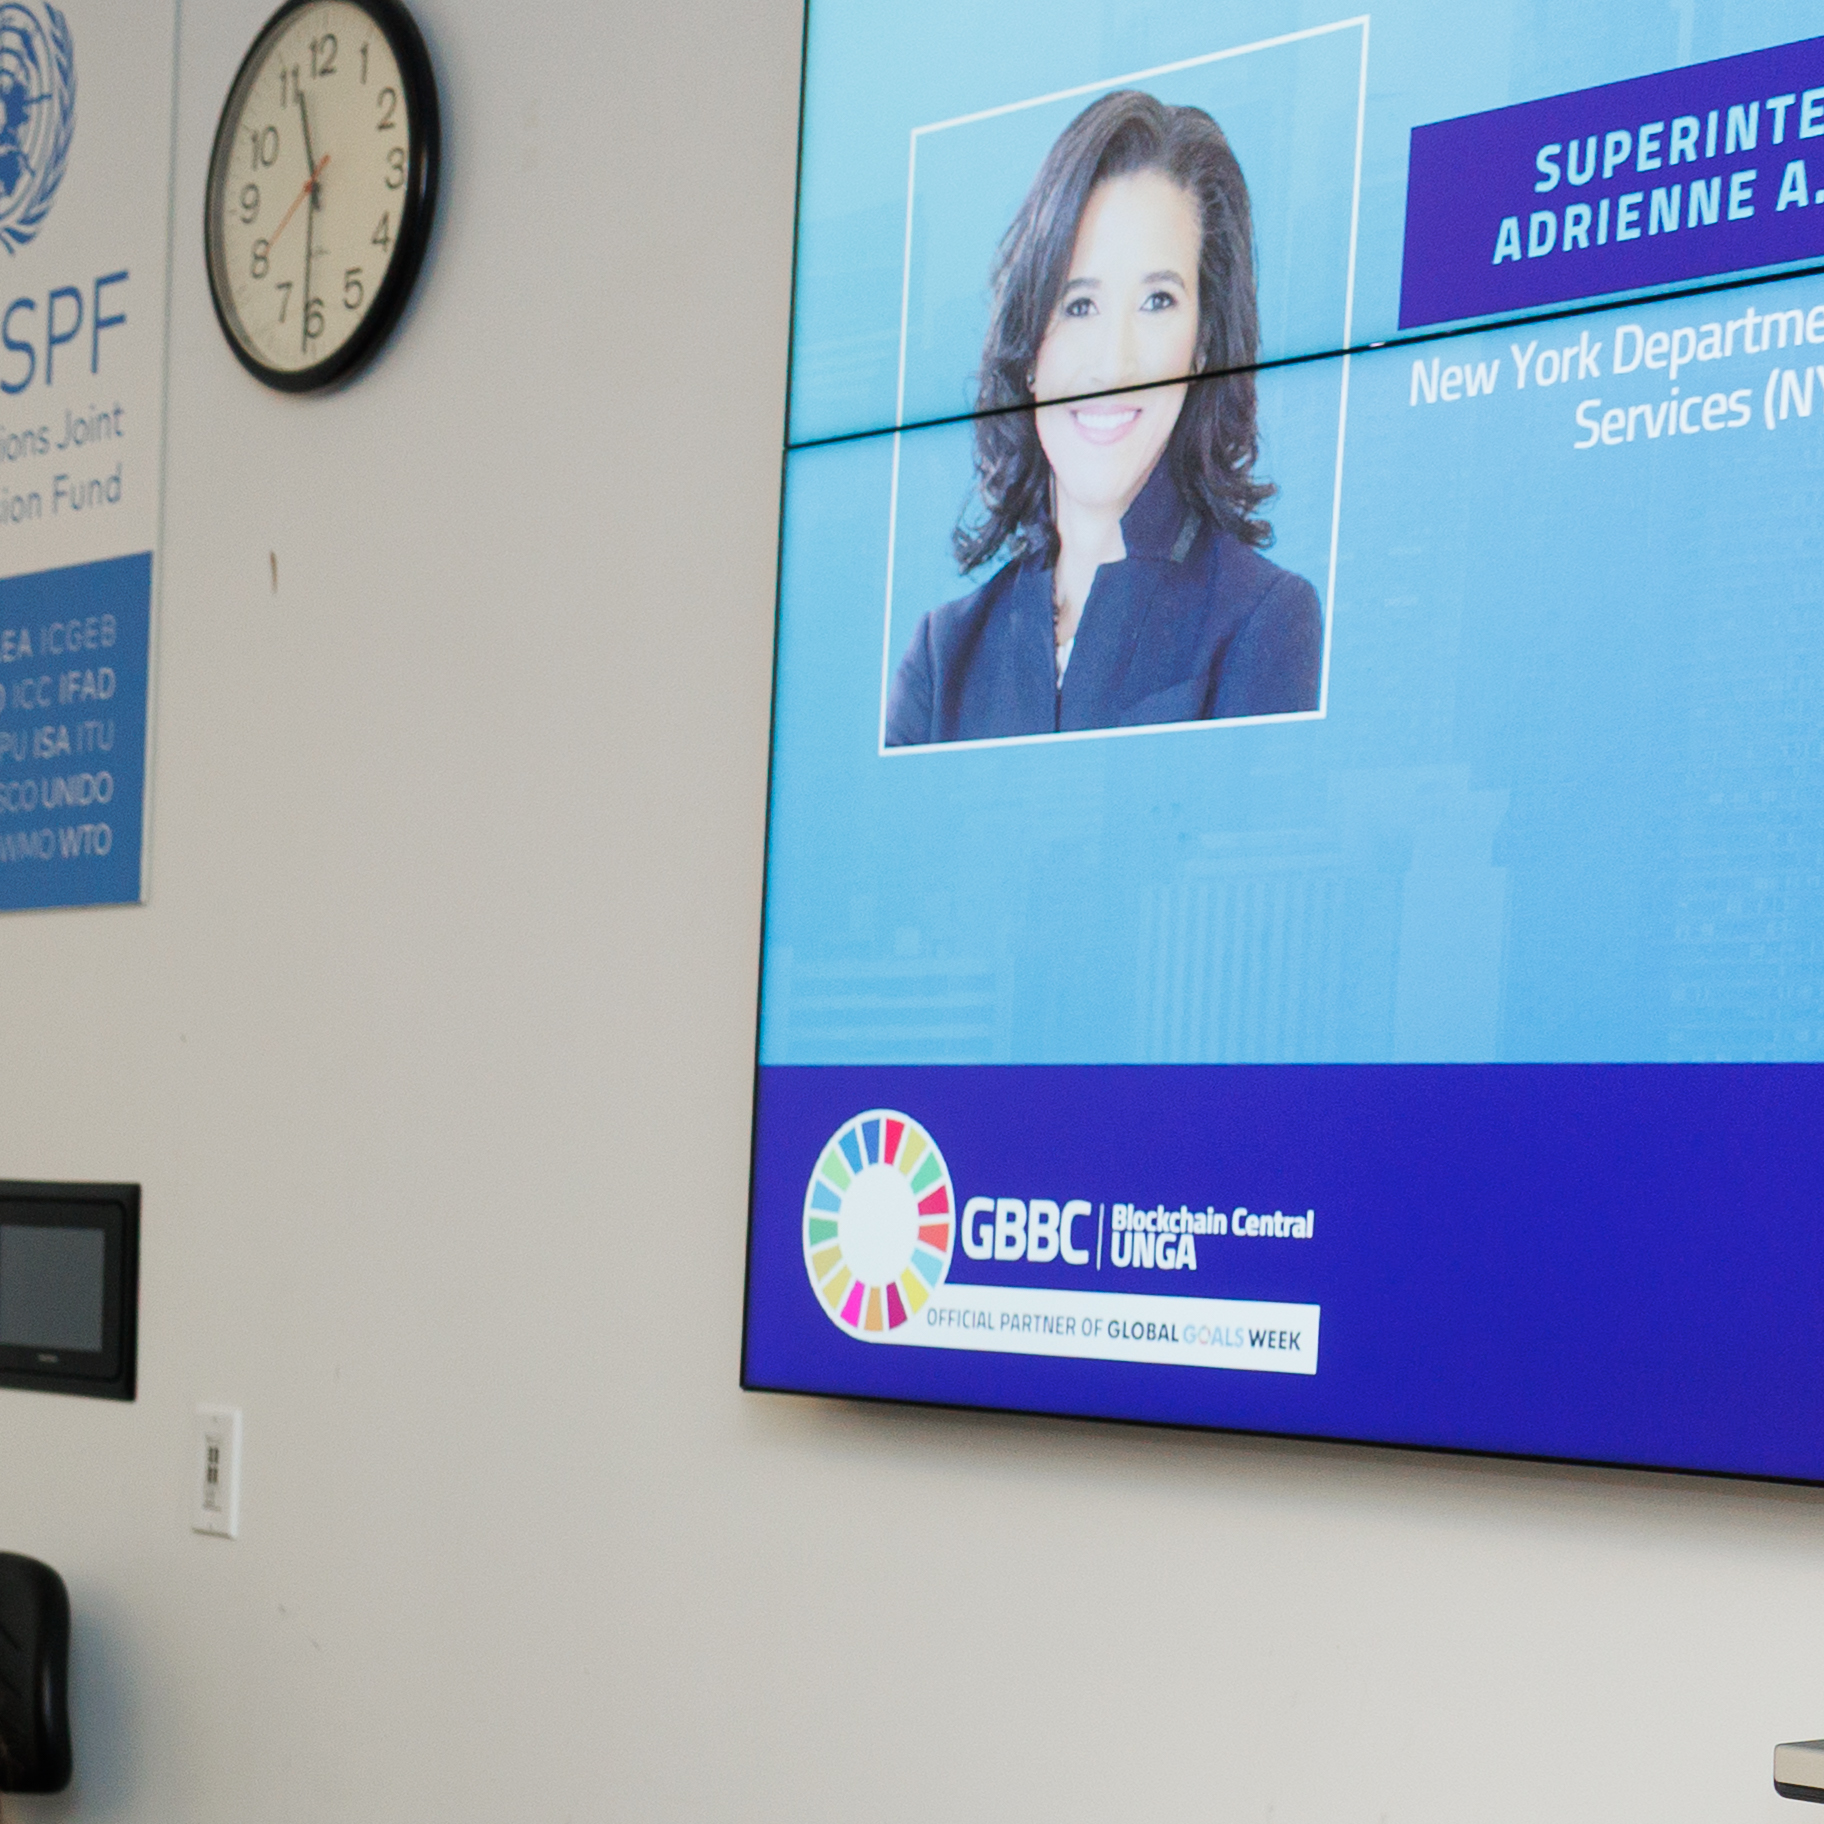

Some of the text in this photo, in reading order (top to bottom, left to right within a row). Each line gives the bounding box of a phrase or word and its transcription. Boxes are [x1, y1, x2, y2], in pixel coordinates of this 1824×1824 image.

[309, 33, 339, 79] 12
[360, 41, 370, 85] 1
[279, 63, 303, 108] 11
[376, 86, 398, 131] 2
[251, 125, 279, 171] 10
[1534, 85, 1824, 193] SUPERINTE
[384, 146, 406, 190] 3
[240, 183, 260, 224] 9
[1491, 159, 1824, 265] ADRIENNE A.
[371, 210, 392, 251] 4
[251, 238, 269, 279] 8
[276, 281, 293, 323] 7
[343, 267, 364, 310] 5
[305, 297, 325, 340] 6
[1409, 304, 1824, 407] New York Departme
[56, 401, 124, 450] Joint
[1573, 387, 1753, 450] Services
[53, 461, 123, 516] Fund
[40, 613, 117, 656] ICGEB
[12, 676, 52, 711] ICC
[58, 666, 117, 705] IFAD
[33, 724, 70, 759] ISA
[77, 718, 114, 753] ITU
[58, 822, 112, 860] WTO
[961, 1196, 1092, 1266] GBBC
[1111, 1203, 1315, 1240] Blockchain Central
[1110, 1231, 1197, 1271] UNGA
[926, 1306, 1301, 1350] OFFICIAL PARTNER OF GLOBAL GOALS WEEK
